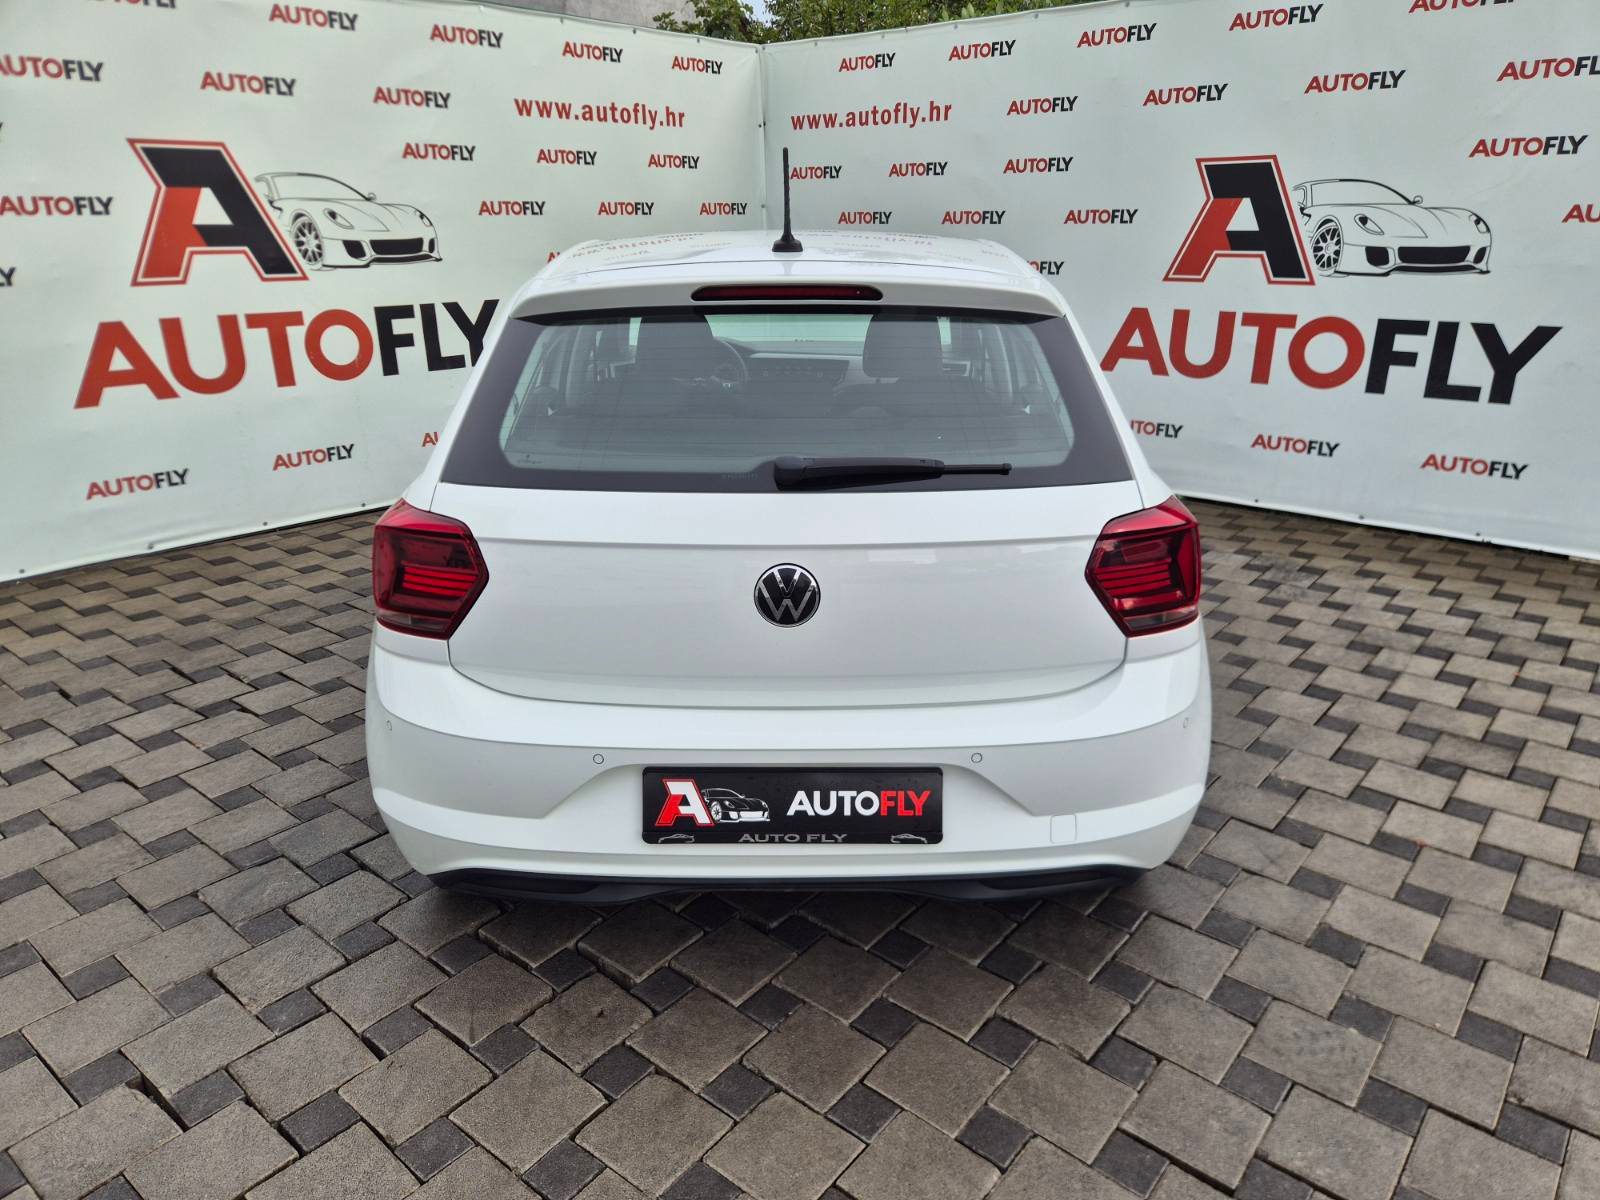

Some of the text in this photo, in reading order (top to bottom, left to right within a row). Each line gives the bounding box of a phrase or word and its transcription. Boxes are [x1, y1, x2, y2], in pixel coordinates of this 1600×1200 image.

[269, 4, 358, 31] AUTOFLY
[1229, 4, 1324, 31] AUTOFLY
[430, 24, 503, 48] AUTOFLY
[1077, 23, 1157, 48] AUTOFLY
[562, 41, 623, 63] AUTOFLY
[838, 52, 896, 72] AUTOFLY
[949, 40, 1016, 61] AUTOFLY
[672, 56, 722, 74] AUTOFLY
[1496, 56, 1600, 82] AUTOFL
[200, 71, 296, 96] AUTOFLY
[1304, 70, 1406, 95] AUTOFLY
[373, 86, 451, 109] AUTOFLY
[1007, 96, 1078, 116] AUTOFLY
[1143, 83, 1228, 106] AUTOFLY
[514, 98, 685, 130] www.autofly.hr
[791, 101, 952, 130] www.autofly.hr
[402, 142, 476, 161] AUTOFLY
[537, 149, 597, 167] AUTOFLY
[1468, 135, 1589, 158] AUTOFLY
[648, 154, 699, 169] AUTOFLY
[790, 165, 842, 179] AUTOFLY
[889, 161, 948, 177] AUTOFLY
[1003, 156, 1073, 174] AUTOFLY
[0, 196, 113, 216] AUTOFLY
[126, 138, 309, 286] A
[478, 201, 546, 216] AUTOFLY
[598, 201, 654, 216] AUTOFLY
[700, 201, 749, 216] AUTOFLY
[941, 210, 1006, 225] AUTOFLY
[1064, 208, 1138, 224] AUTOFLY
[838, 211, 892, 225] AUTOFLY
[1162, 154, 1316, 286] A
[74, 299, 500, 409] AUTOFLY
[1100, 307, 1563, 405] AUTOFLY
[1130, 420, 1183, 438] TOFLY
[273, 443, 354, 471] AUTOFLY
[1251, 434, 1340, 457] AUTOFLY
[1420, 453, 1528, 480] AUTOFLY
[86, 468, 189, 500] AUTOFLY
[786, 790, 932, 817] AUTOFLY
[738, 833, 848, 843] AUTO FLY
